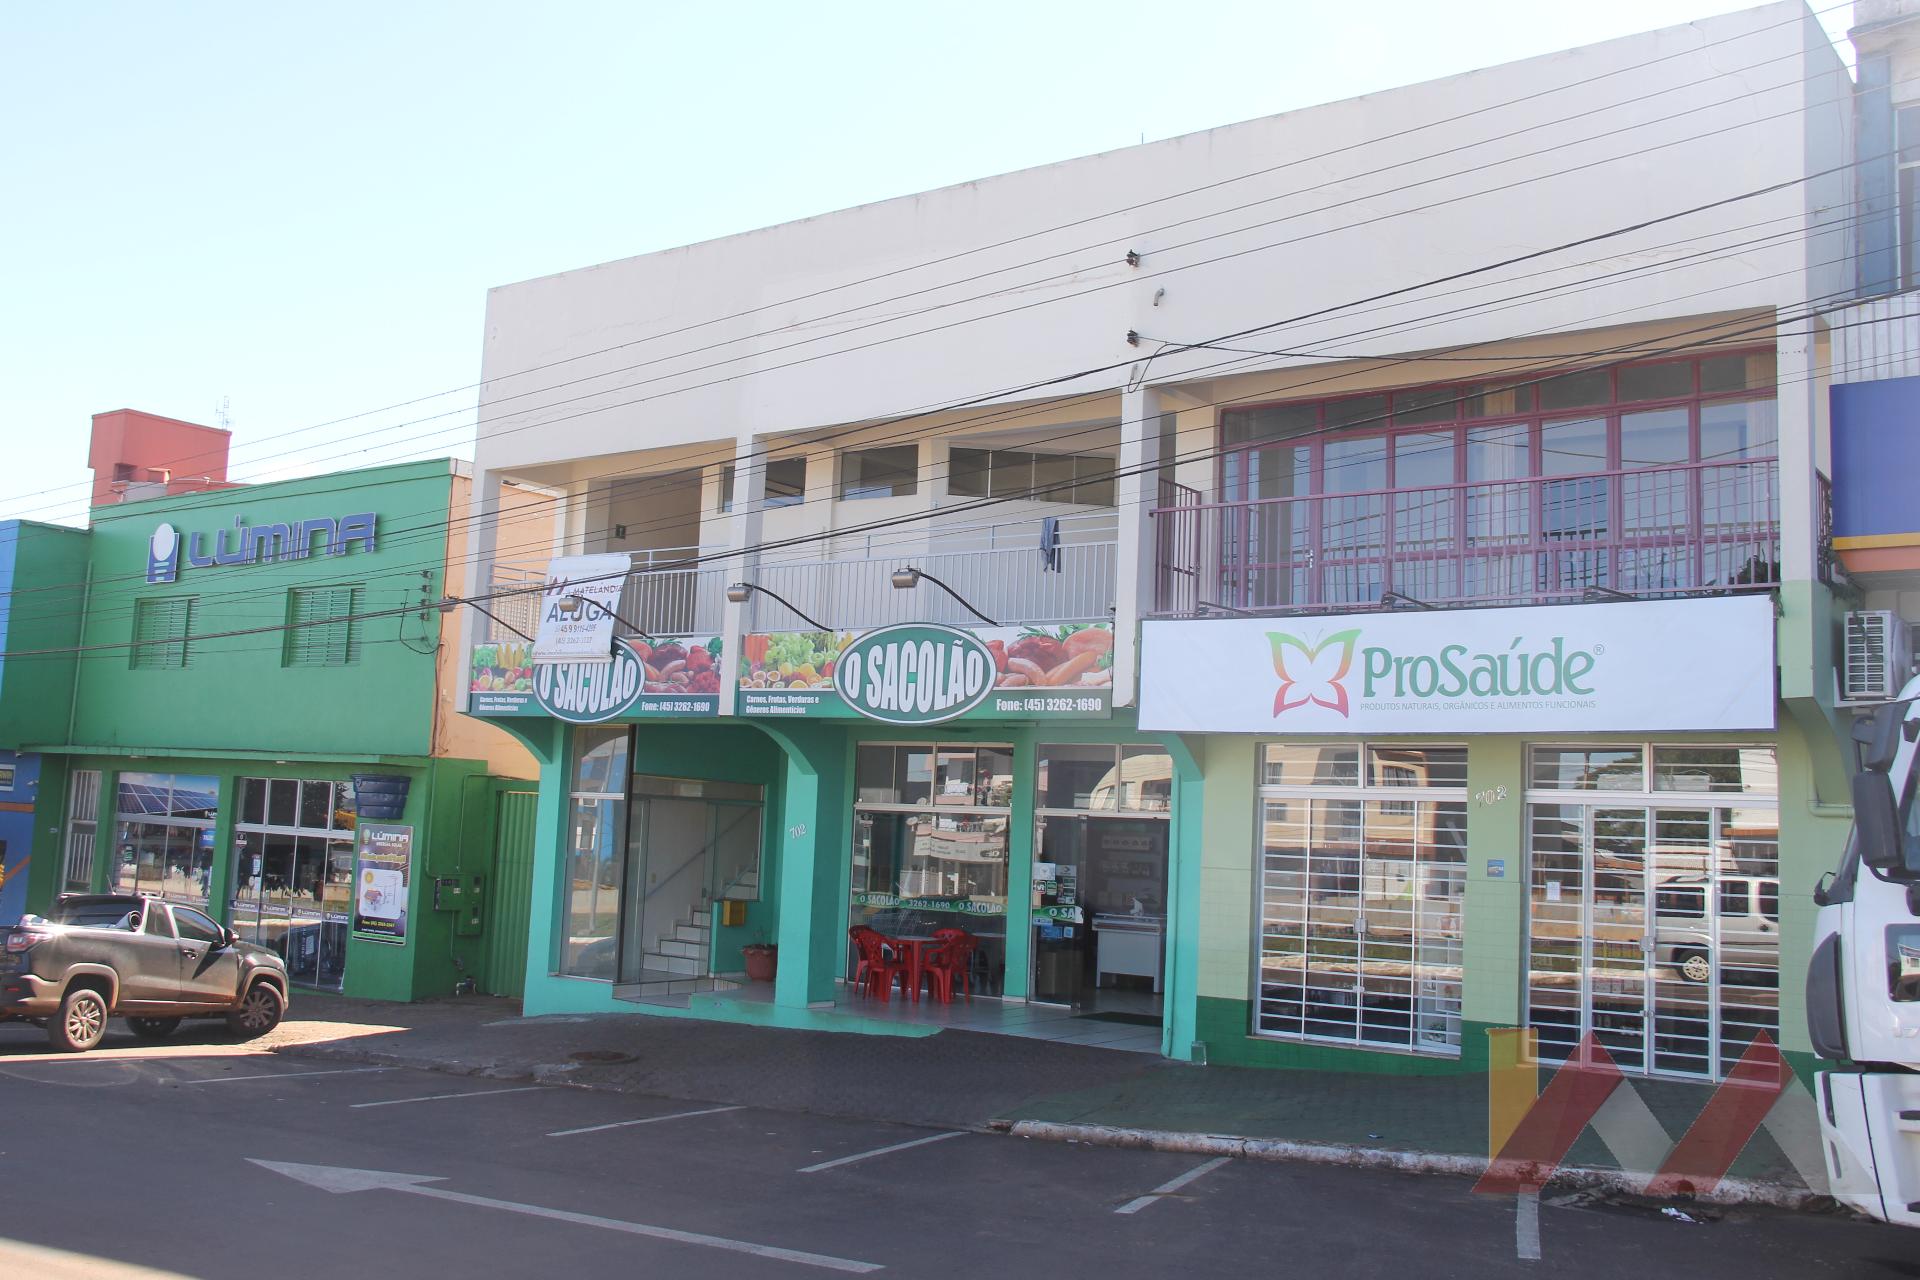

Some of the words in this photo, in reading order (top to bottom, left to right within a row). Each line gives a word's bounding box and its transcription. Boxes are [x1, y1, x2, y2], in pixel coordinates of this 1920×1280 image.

[189, 512, 376, 567] LÚMINA
[1361, 637, 1595, 697] ProSaúde
[844, 652, 861, 699] O
[866, 639, 984, 713] SACOLÃO
[642, 701, 659, 711] Fone:
[660, 701, 673, 711] (45)
[674, 701, 710, 711] 3262-1690
[788, 695, 814, 704] Verduras
[996, 699, 1023, 711] Fone:
[1024, 698, 1045, 712] (45)
[1047, 698, 1101, 712] 3262-1690
[1360, 702, 1400, 711] PRODUTOS
[1401, 702, 1440, 711] NATURAIS,
[1442, 700, 1488, 711] ORGÂNICOS
[1490, 702, 1495, 710] E
[1497, 701, 1543, 710] ALIMENTOS
[1545, 700, 1596, 709] FUNCIONAIS
[789, 823, 807, 840] 702
